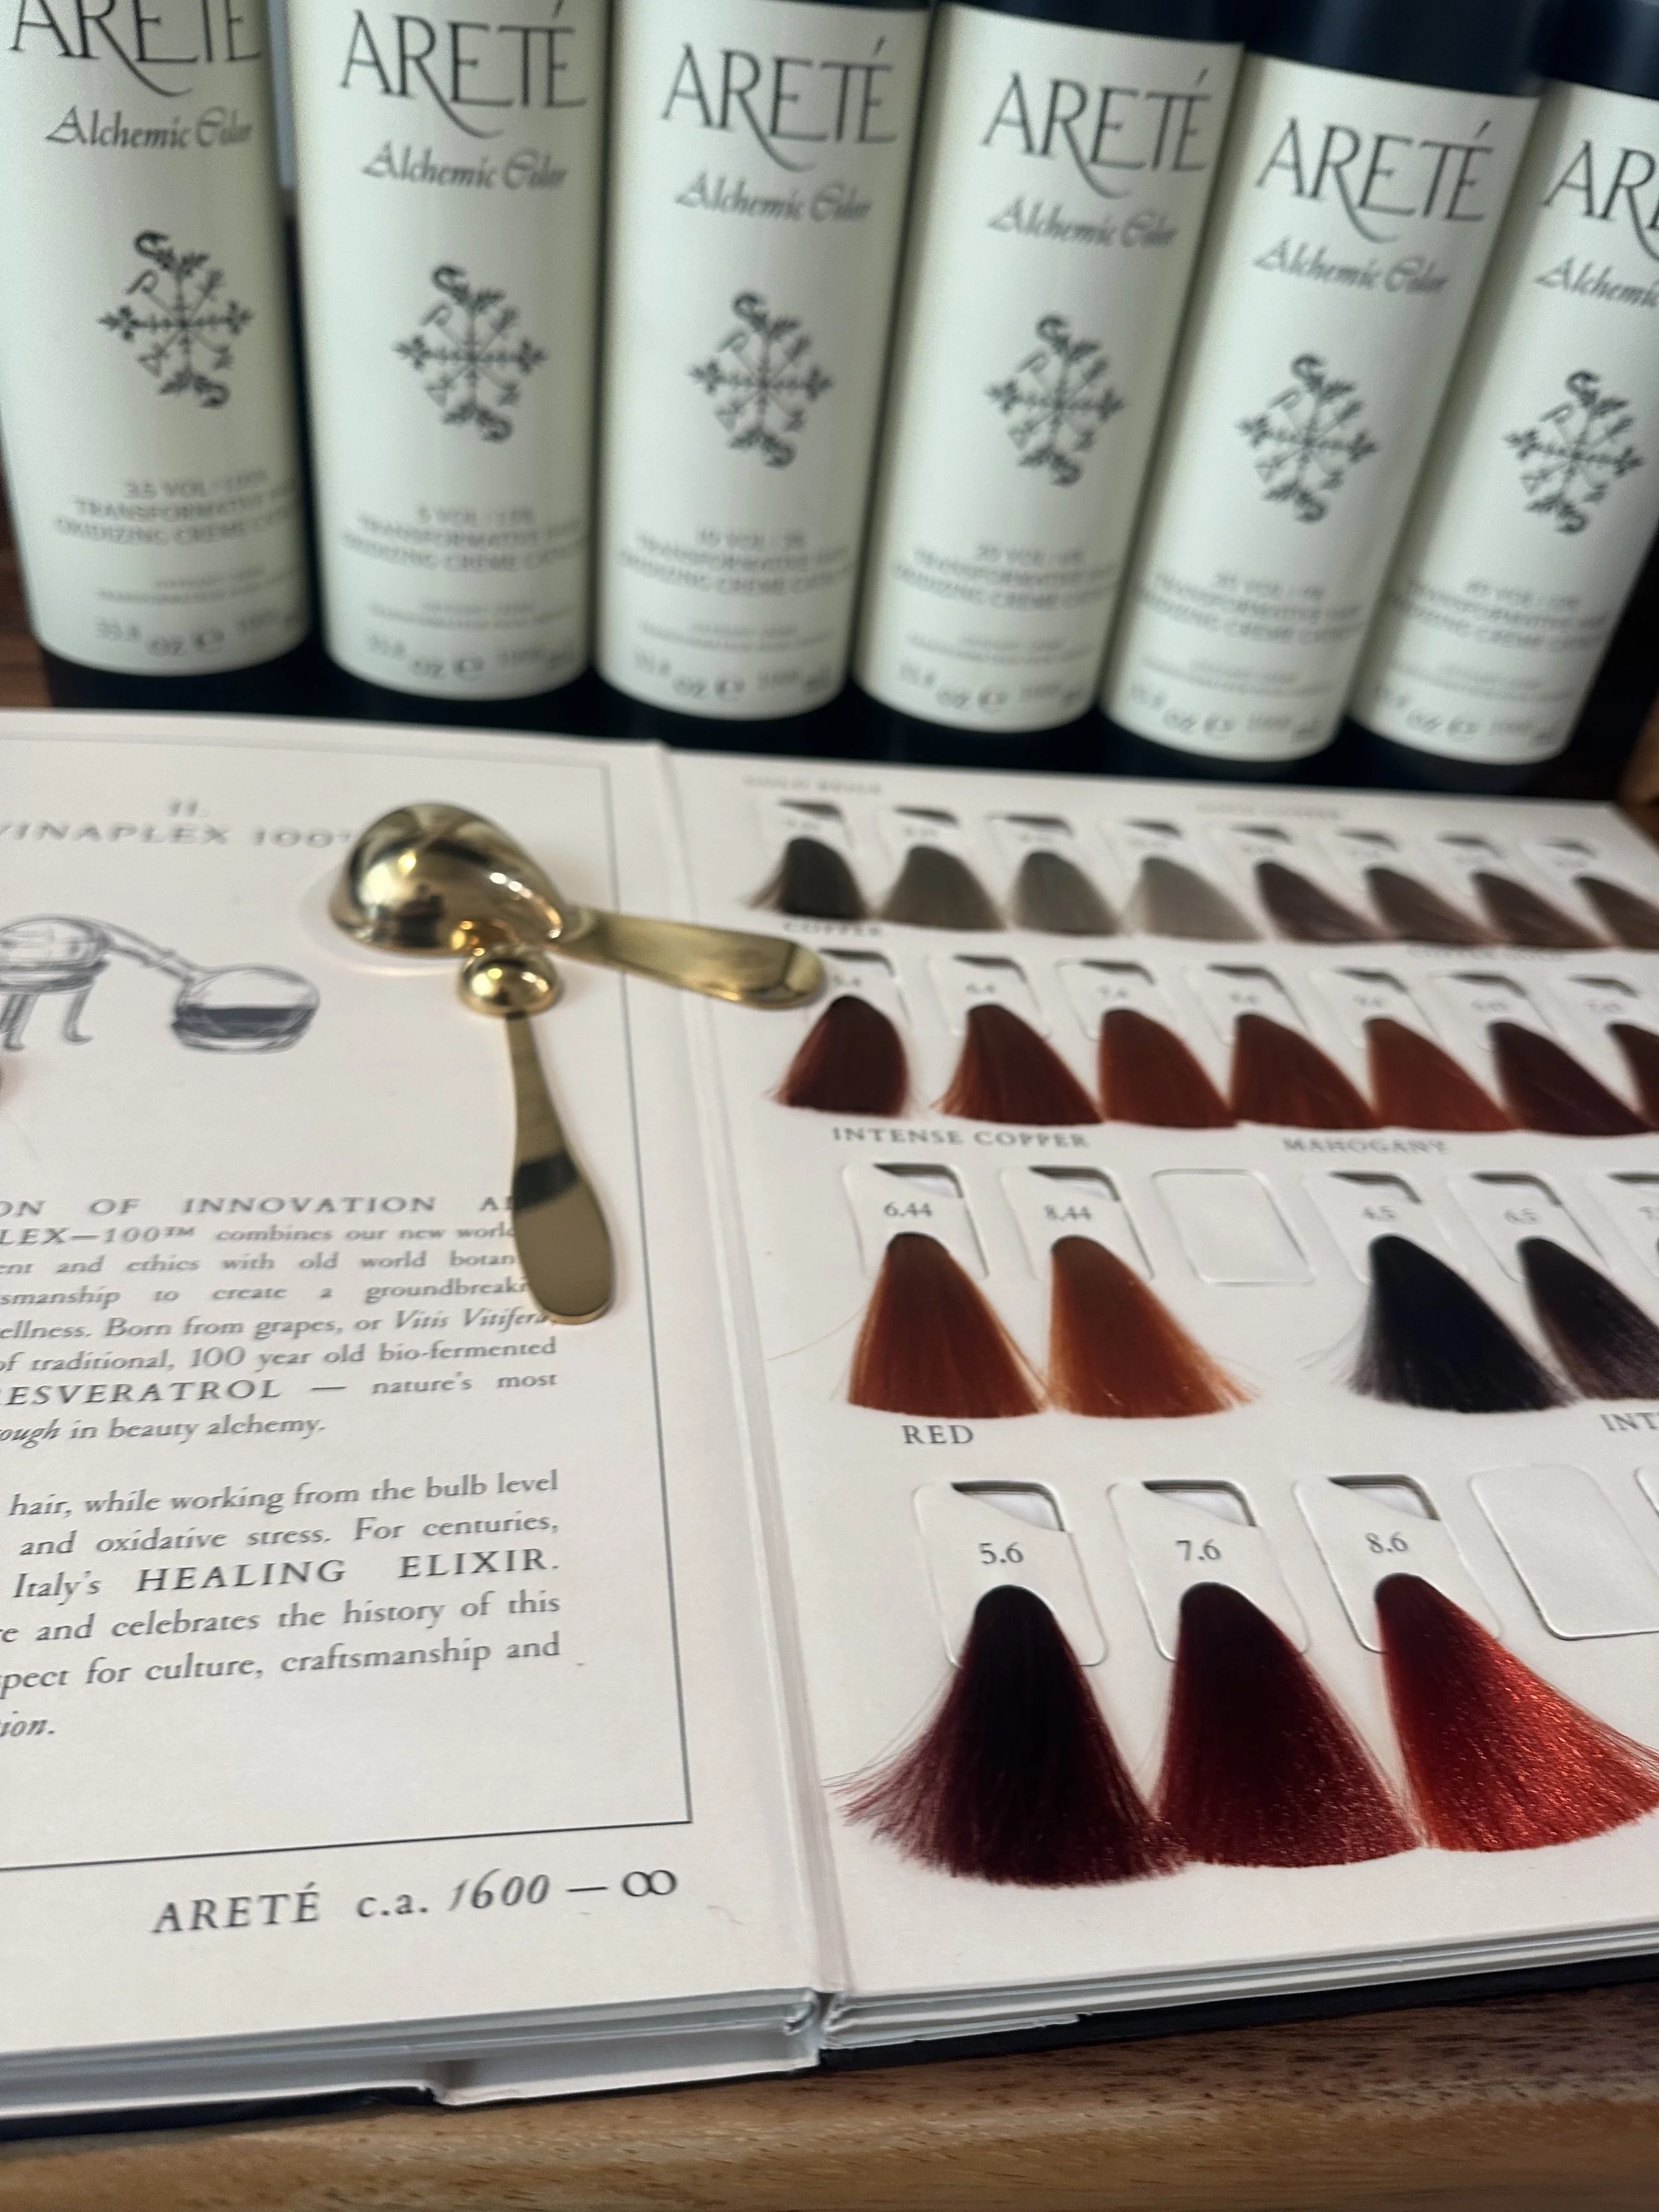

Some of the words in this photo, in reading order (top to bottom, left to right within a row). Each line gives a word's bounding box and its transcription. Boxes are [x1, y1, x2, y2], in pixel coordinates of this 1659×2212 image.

[339, 0, 589, 139] ARETÉ
[660, 35, 897, 173] ARETÉ
[44, 106, 188, 149] Alchemic
[979, 66, 1212, 200] ARETÉ
[360, 140, 500, 188] Alchemic
[1254, 119, 1494, 245] ARETÉ
[1542, 138, 1659, 261] AR
[832, 1127, 964, 1145] INTENSE
[974, 1130, 1090, 1149] COPPER
[1282, 1138, 1449, 1155] MAHOGANY
[88, 1198, 140, 1216] OF
[182, 1196, 437, 1215] INNOVATION
[883, 1201, 934, 1220] 6.44
[1044, 1203, 1093, 1222] 8.44
[215, 1224, 333, 1242] combines
[344, 1229, 388, 1241] our
[398, 1228, 446, 1240] new
[56, 1254, 106, 1274] and
[125, 1253, 200, 1273] ethics
[222, 1252, 276, 1271] with
[299, 1251, 340, 1269] old
[360, 1250, 428, 1268] world
[153, 1289, 180, 1302] to
[211, 1288, 287, 1301] create
[319, 1288, 333, 1299] a
[104, 1316, 172, 1338] Born
[180, 1315, 244, 1335] from
[252, 1319, 344, 1341] grapes,
[352, 1319, 384, 1331] or
[397, 1308, 451, 1329] Vitis
[31, 1348, 177, 1372] traditional,
[189, 1345, 246, 1368] 100
[254, 1353, 312, 1372] year
[323, 1343, 366, 1364] old
[379, 1336, 557, 1362] bio-fermented
[0, 1378, 283, 1406] ESVERATROL
[371, 1370, 474, 1396] nature's
[496, 1372, 558, 1389] most
[70, 1419, 98, 1439] in
[108, 1416, 200, 1444] beauty
[206, 1413, 327, 1439] alchemy.
[901, 1425, 974, 1444] RED
[1599, 1412, 1659, 1431] INT
[7, 1493, 72, 1518] hair,
[84, 1489, 161, 1512] while
[170, 1485, 285, 1514] working
[293, 1482, 360, 1505] from
[371, 1478, 416, 1501] the
[425, 1473, 488, 1498] bulb
[497, 1468, 558, 1493] level
[19, 1530, 78, 1556] and
[95, 1526, 228, 1553] oxidative
[246, 1528, 332, 1546] stress.
[353, 1516, 405, 1541] For
[421, 1510, 559, 1537] centuries,
[1174, 1538, 1222, 1562] 7.6
[1364, 1531, 1409, 1554] 8.6
[977, 1542, 1024, 1564] 5.6
[11, 1570, 102, 1606] Italy's
[135, 1559, 347, 1592] HEALING
[397, 1548, 559, 1578] ELIXIR.
[35, 1612, 96, 1641] and
[111, 1607, 260, 1637] celebrates
[277, 1601, 327, 1627] the
[343, 1599, 446, 1629] history
[459, 1590, 496, 1617] of
[508, 1589, 561, 1615] this
[84, 1656, 132, 1685] for
[145, 1651, 263, 1680] culture,
[280, 1637, 492, 1671] craftsmanship
[506, 1631, 561, 1659] and
[151, 1881, 322, 1935] ARETÉ
[356, 1891, 429, 1919] c.a.
[447, 1867, 551, 1913] 1600
